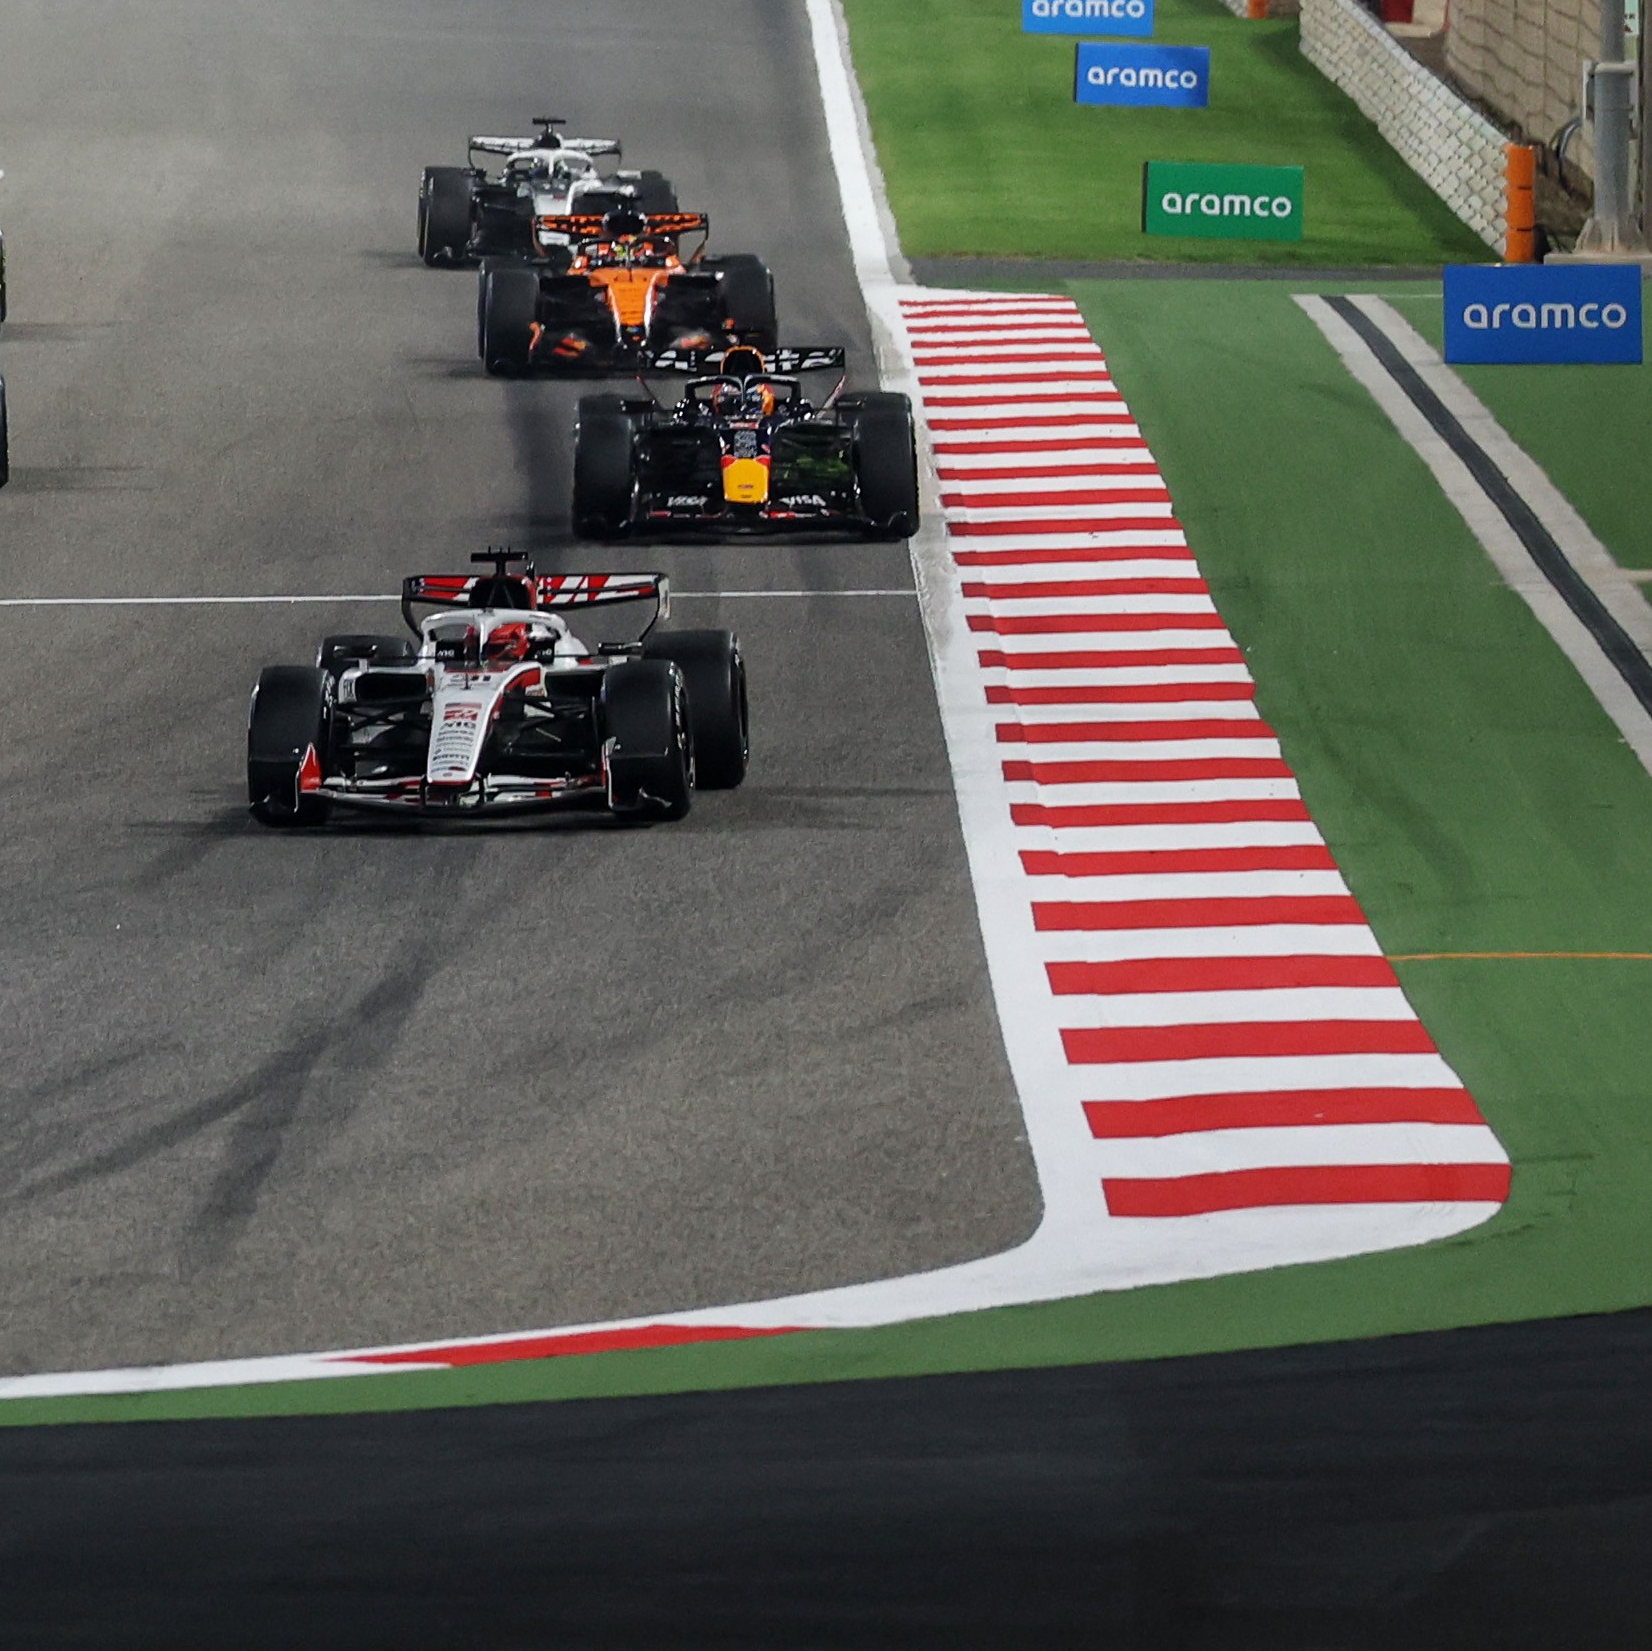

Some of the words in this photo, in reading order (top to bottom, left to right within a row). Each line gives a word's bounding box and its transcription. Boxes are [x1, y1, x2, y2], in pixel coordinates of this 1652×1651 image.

[1087, 66, 1197, 89] aramco
[1161, 192, 1292, 218] aramco
[1463, 302, 1627, 329] aramco
